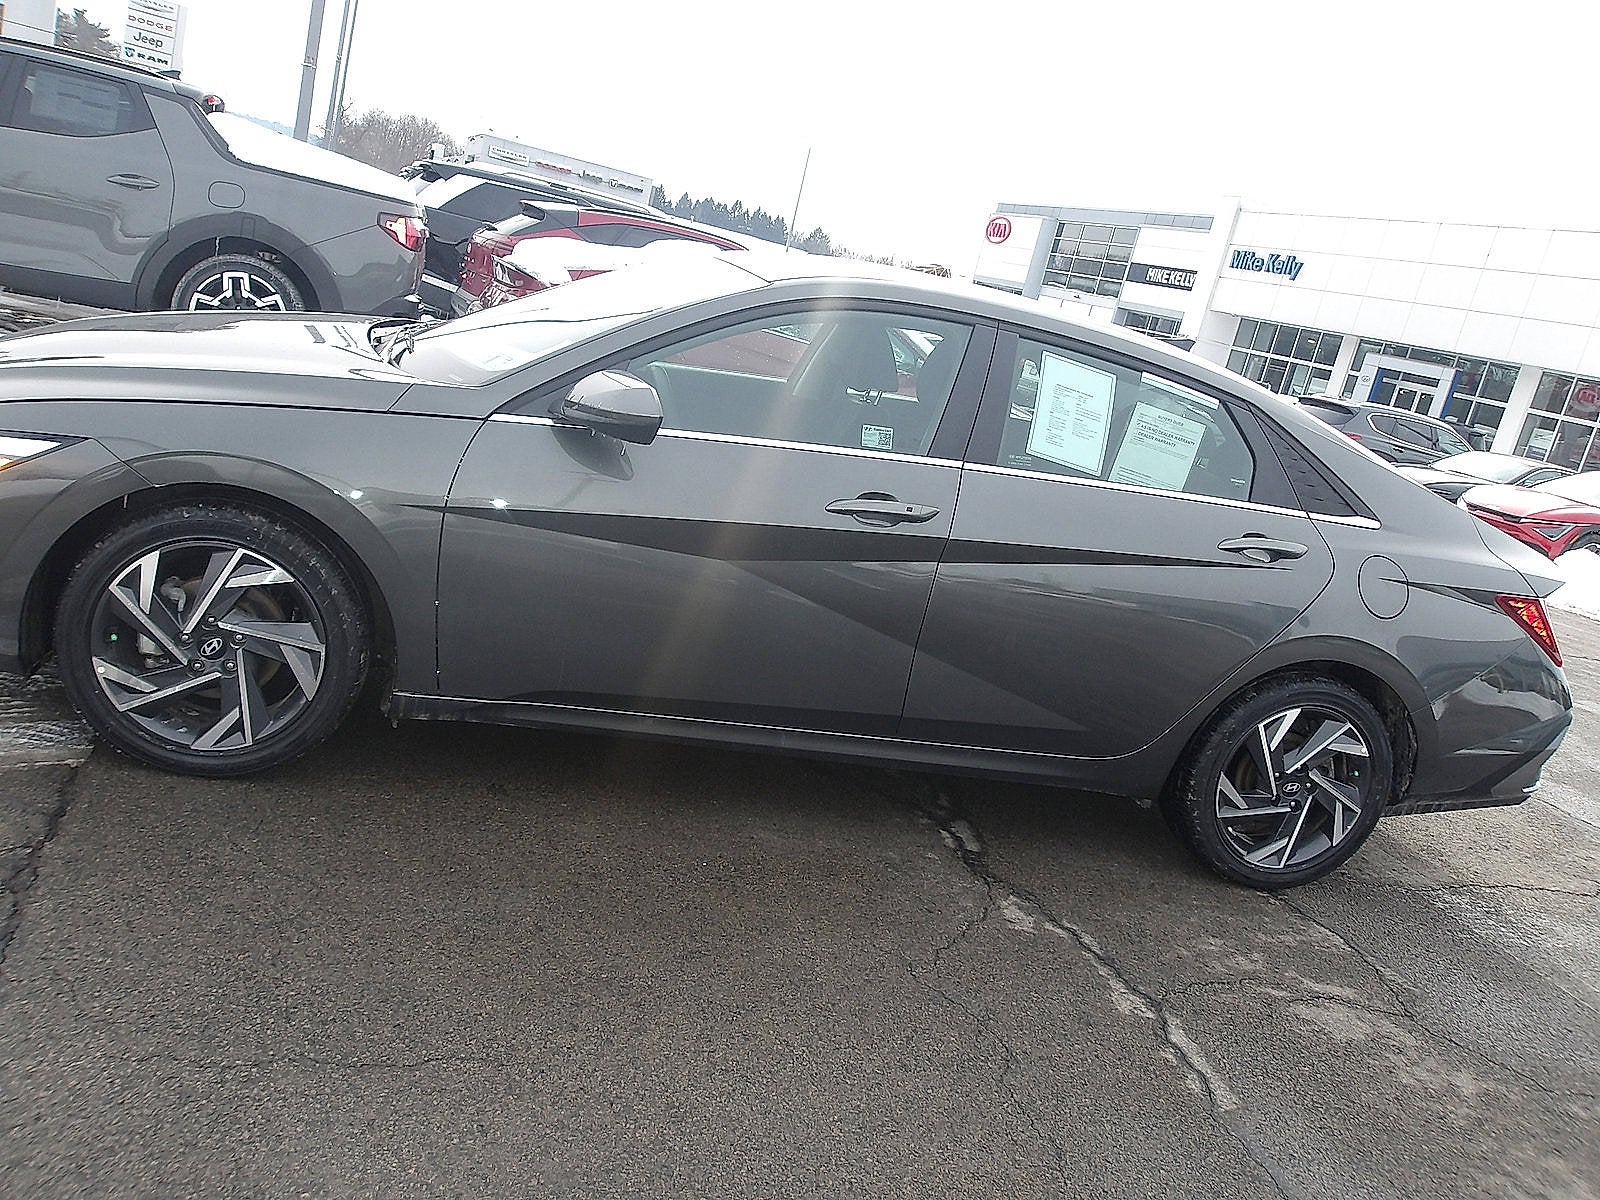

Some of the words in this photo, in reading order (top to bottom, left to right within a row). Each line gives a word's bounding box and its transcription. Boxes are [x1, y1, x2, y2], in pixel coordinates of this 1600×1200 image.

[128, 15, 173, 31] DODGE
[133, 32, 163, 48] Jeep
[137, 52, 169, 65] RAM
[1229, 250, 1265, 272] Mike
[1264, 253, 1305, 281] Kelly
[1145, 267, 1171, 284] MIKE
[1168, 270, 1197, 288] KELLY
